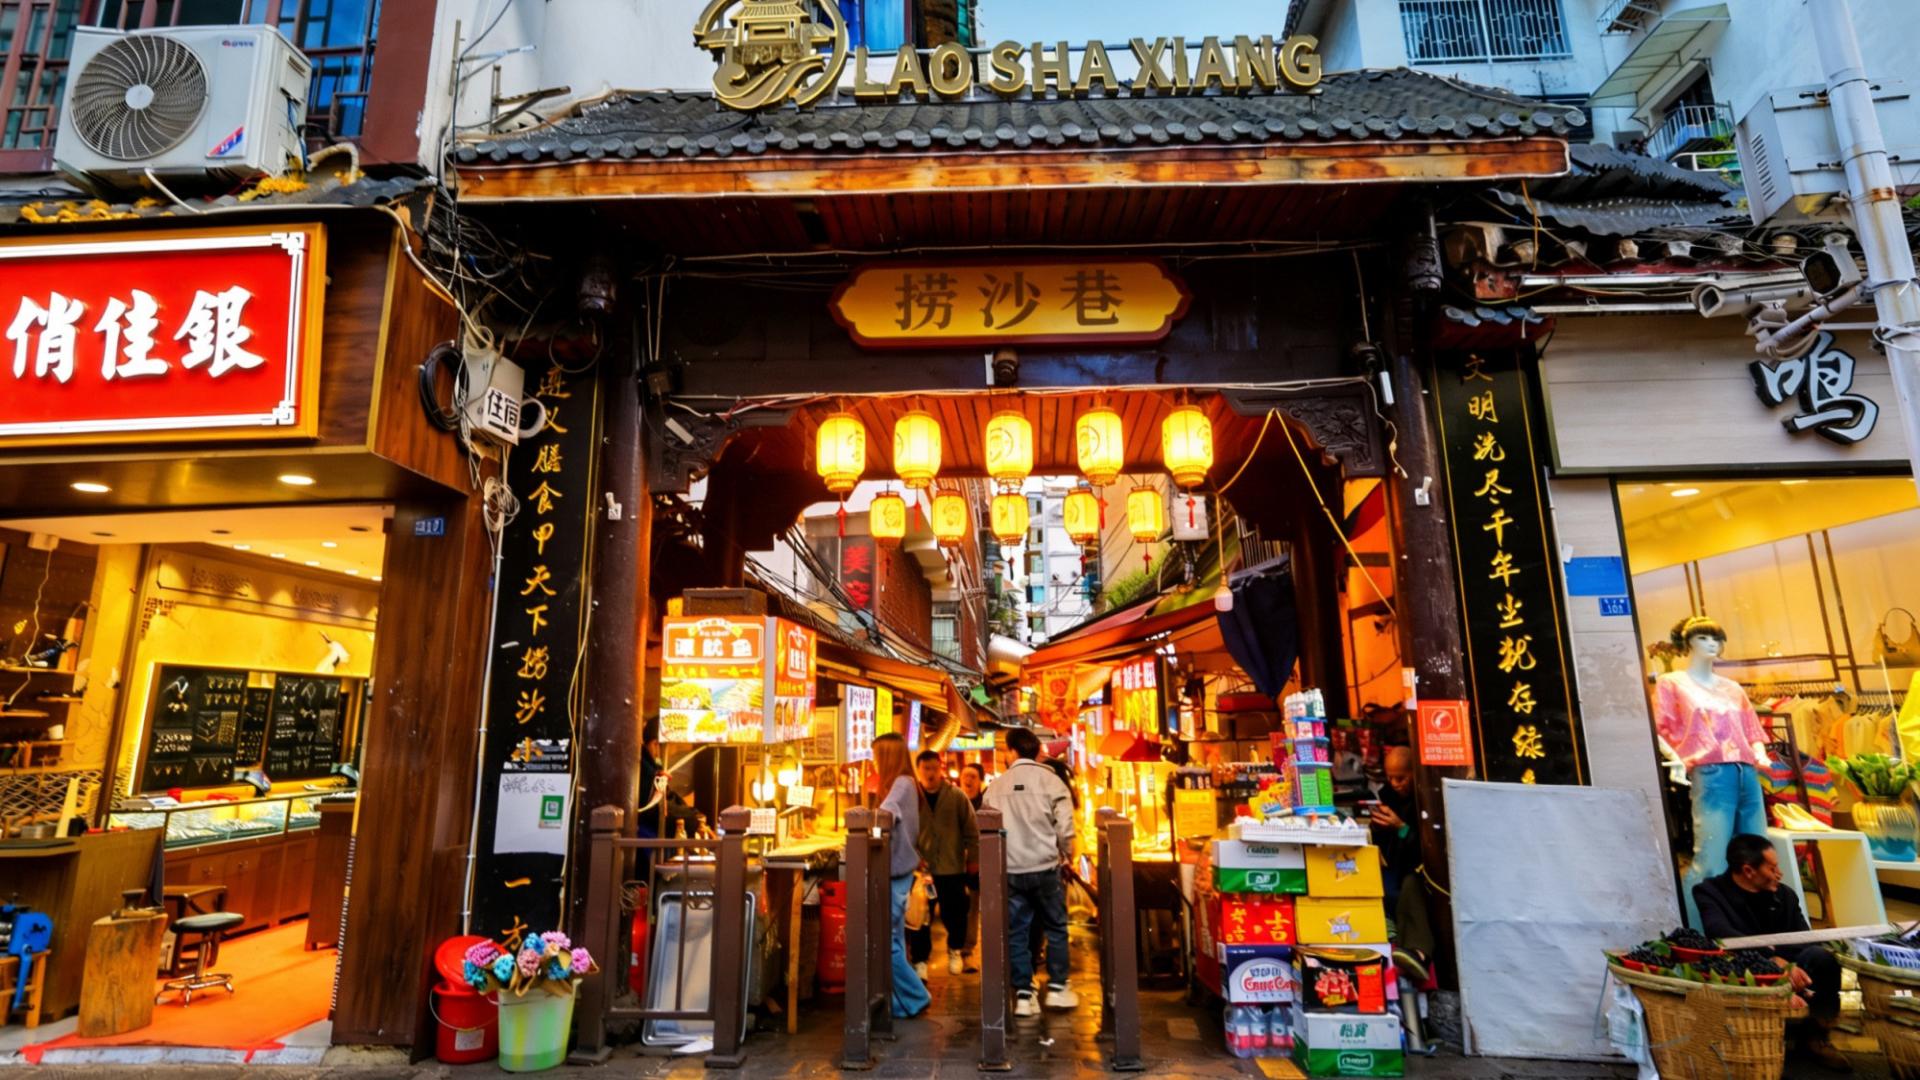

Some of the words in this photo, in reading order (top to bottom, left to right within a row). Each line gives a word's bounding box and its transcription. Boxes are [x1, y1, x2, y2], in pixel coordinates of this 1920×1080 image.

[854, 42, 973, 102] LAO
[990, 40, 1121, 98] SHA
[1130, 34, 1323, 96] XIANG
[895, 269, 1124, 331] 捞沙巷
[5, 285, 267, 384] 俏佳銀
